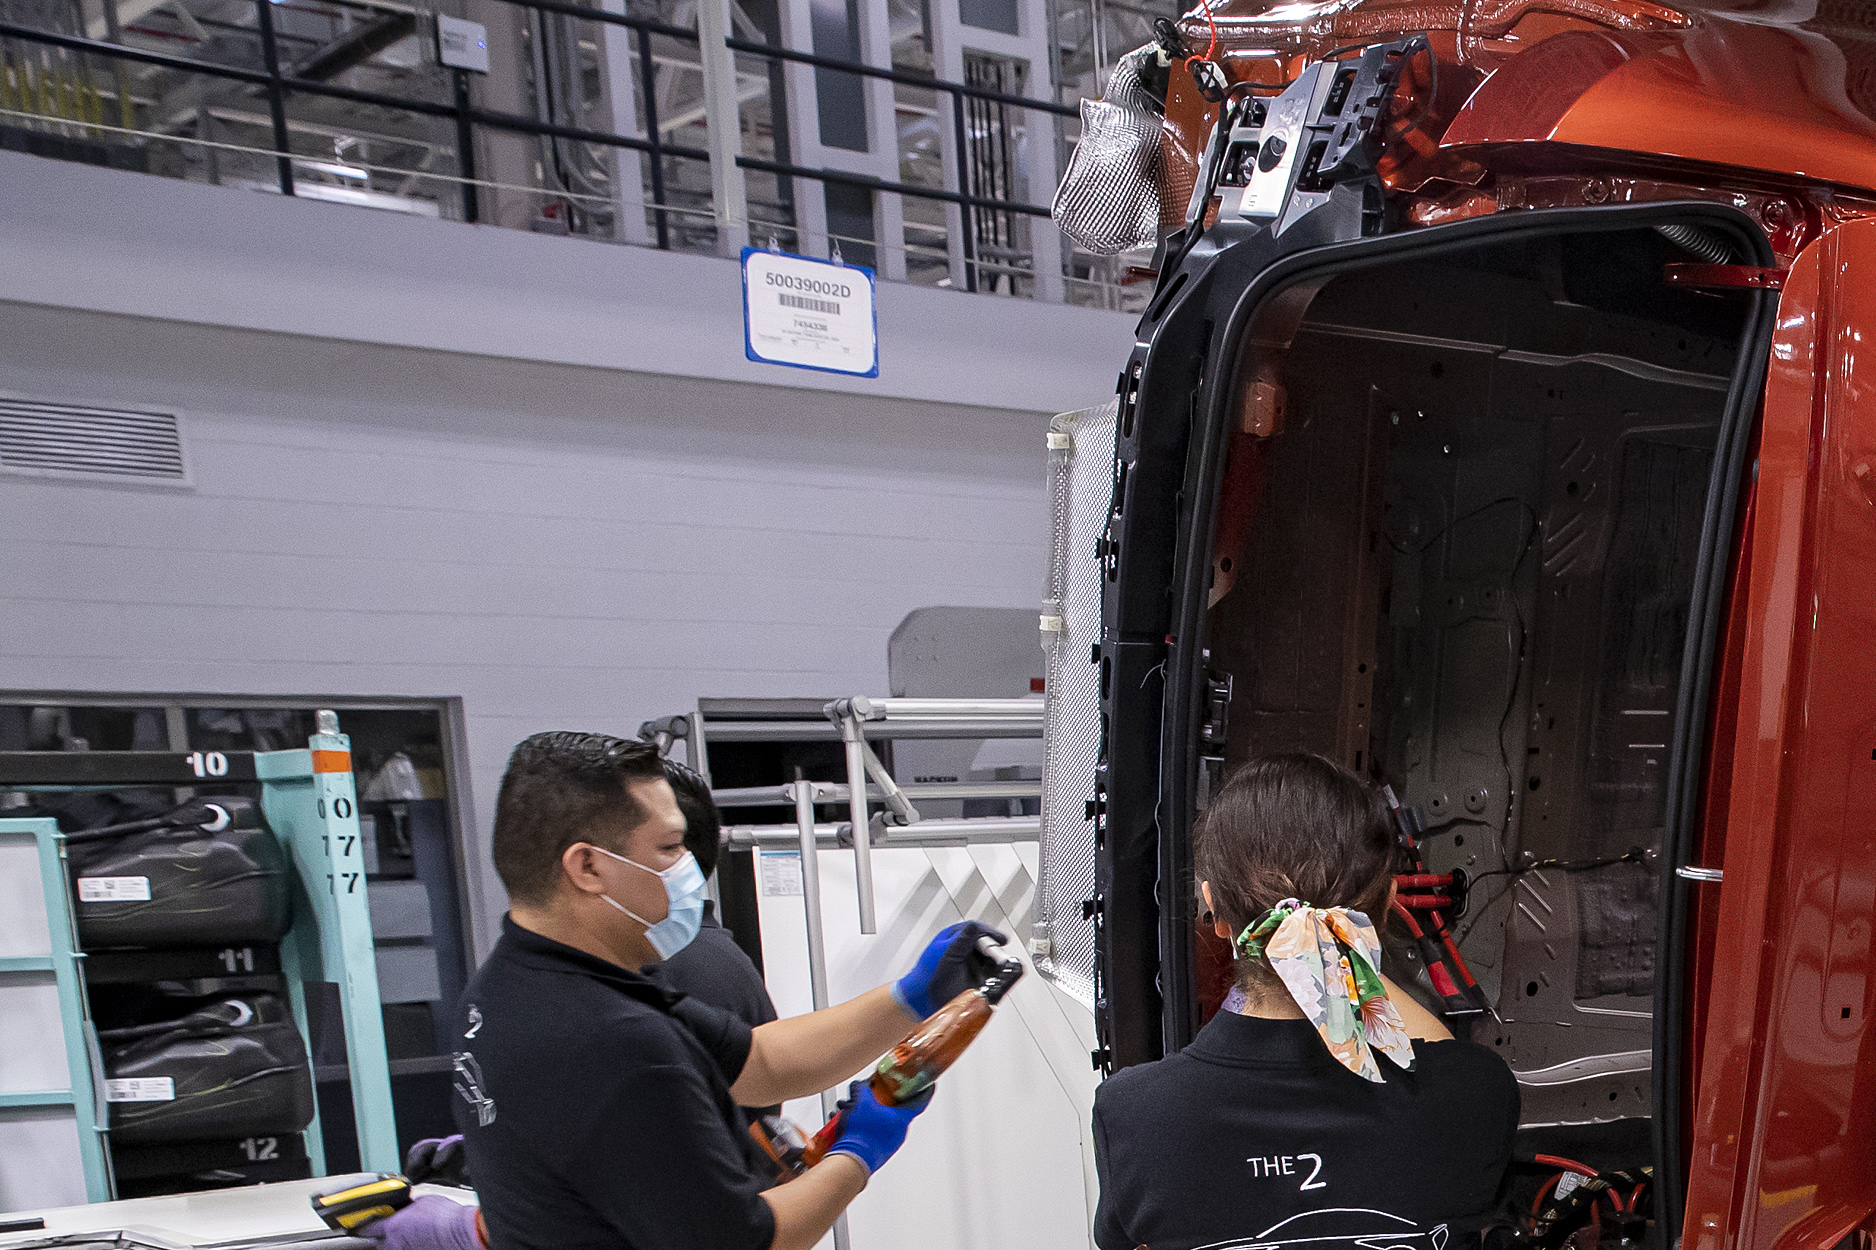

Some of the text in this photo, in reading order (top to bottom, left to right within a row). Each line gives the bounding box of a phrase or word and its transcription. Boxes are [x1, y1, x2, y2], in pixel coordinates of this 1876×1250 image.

[766, 271, 852, 298] 50039002D
[186, 751, 229, 778] 10
[218, 947, 254, 972] 11
[240, 1137, 279, 1160] 12
[1246, 1153, 1327, 1191] THE 2
